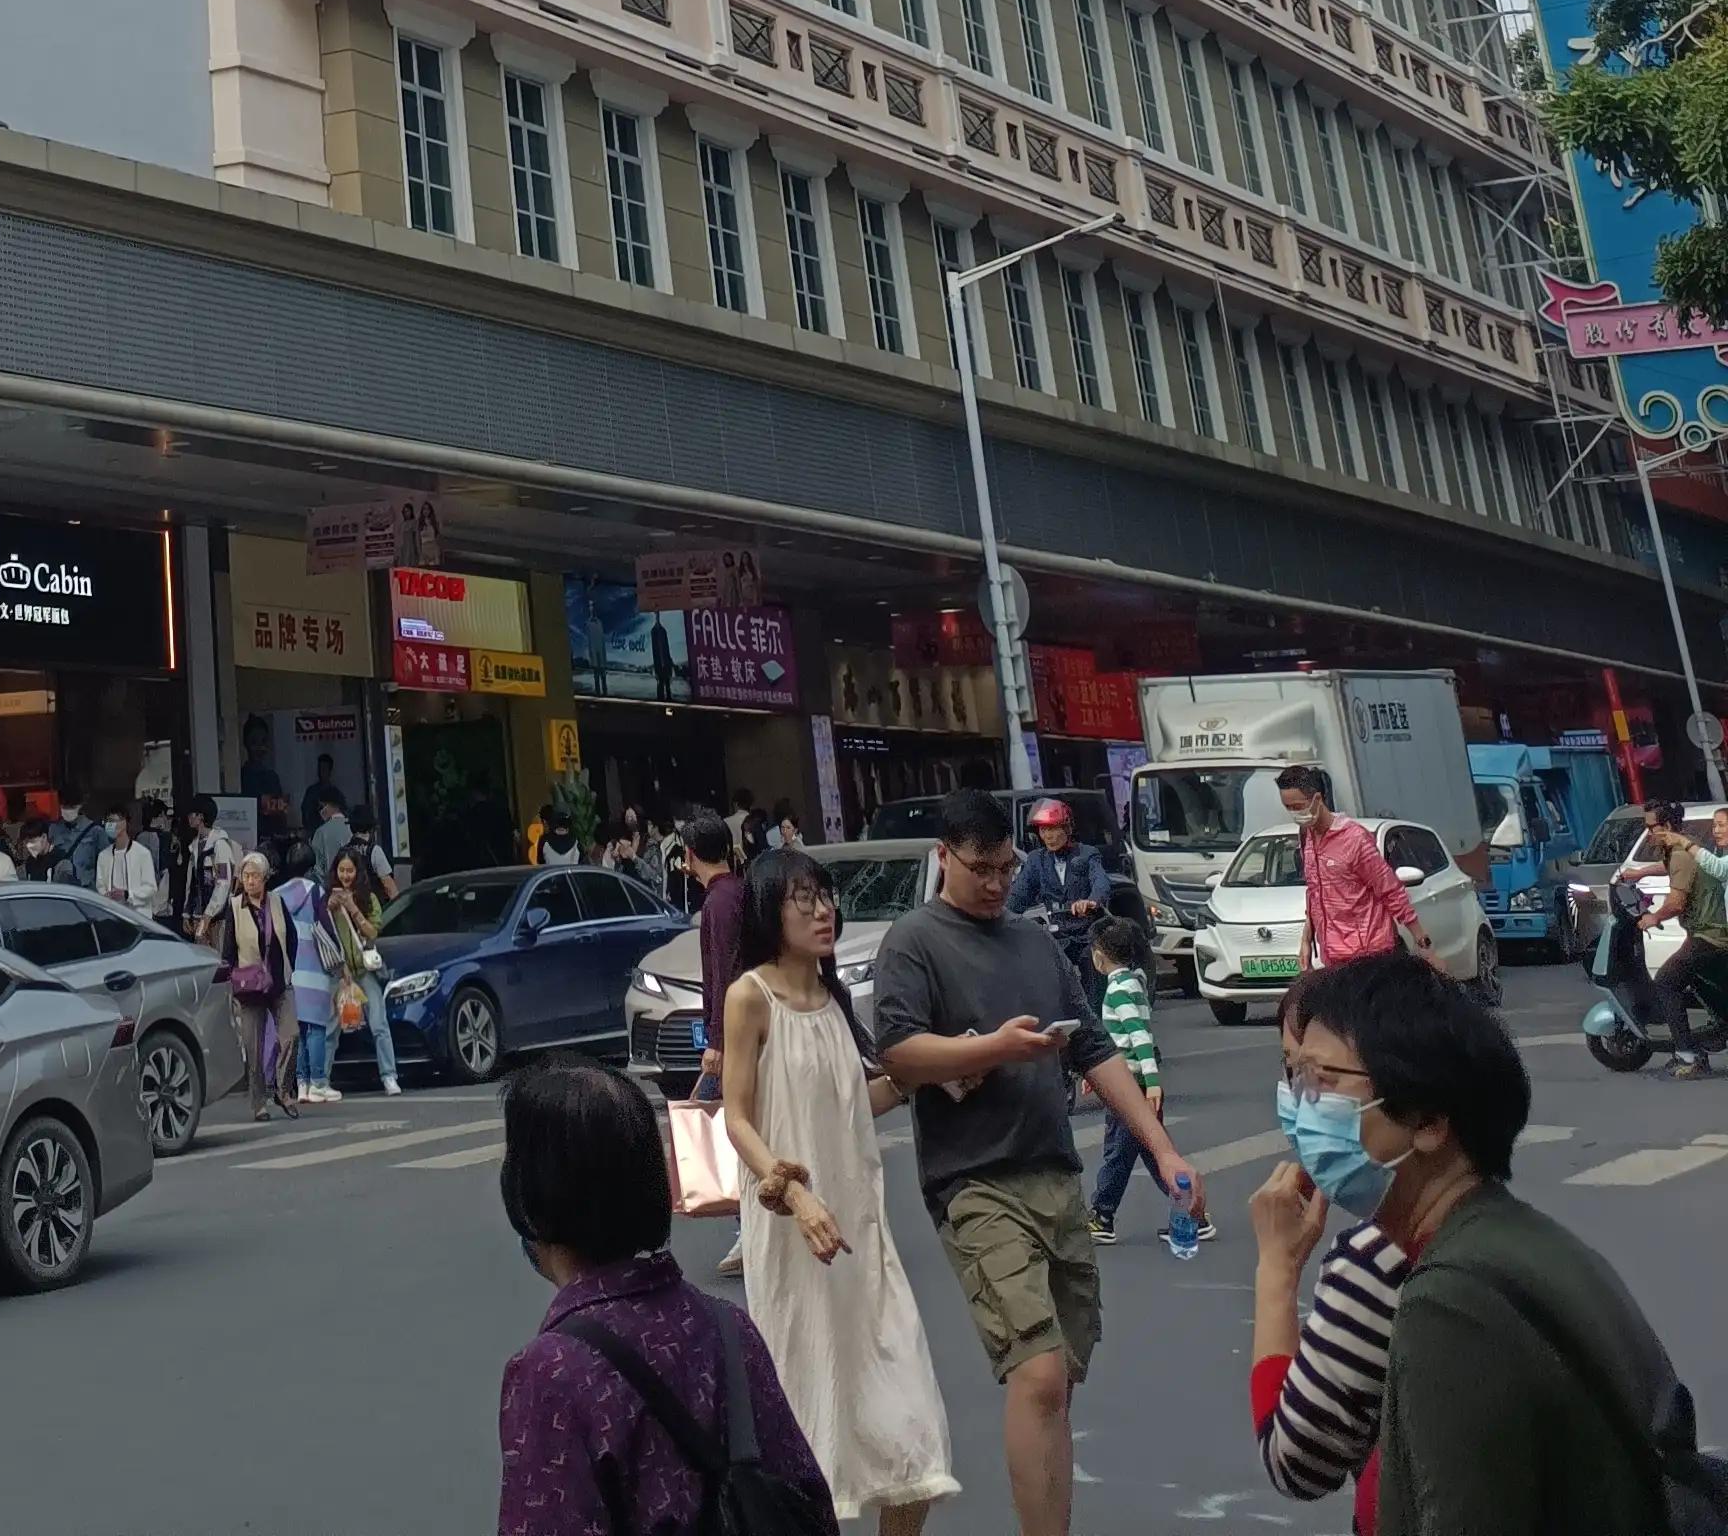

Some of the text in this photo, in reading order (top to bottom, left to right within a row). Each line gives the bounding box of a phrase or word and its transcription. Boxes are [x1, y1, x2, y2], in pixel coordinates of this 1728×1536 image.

[34, 563, 92, 597] Cabin
[254, 611, 345, 656] 品牌专场
[692, 608, 747, 652] FALLE
